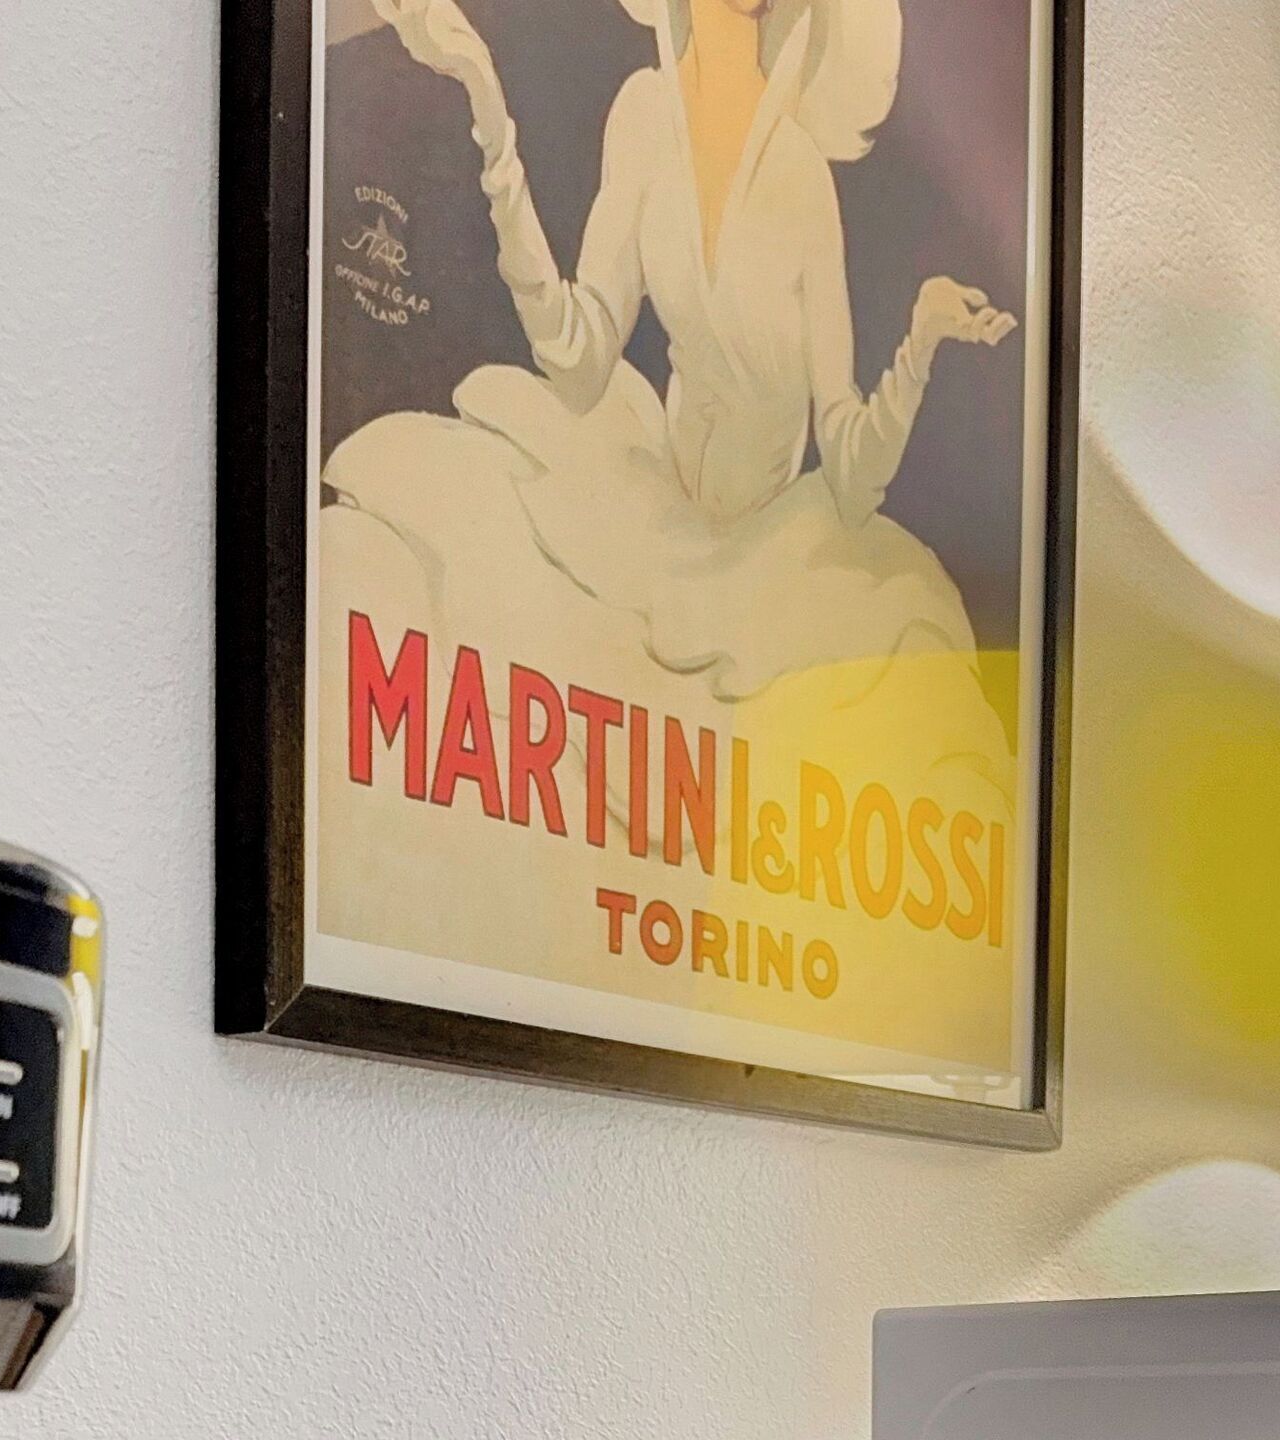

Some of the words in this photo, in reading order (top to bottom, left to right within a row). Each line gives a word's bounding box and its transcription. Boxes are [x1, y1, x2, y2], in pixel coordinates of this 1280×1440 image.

[354, 186, 408, 223] EDIZIONI
[354, 291, 408, 325] MILANO
[596, 887, 840, 1000] TORINO
